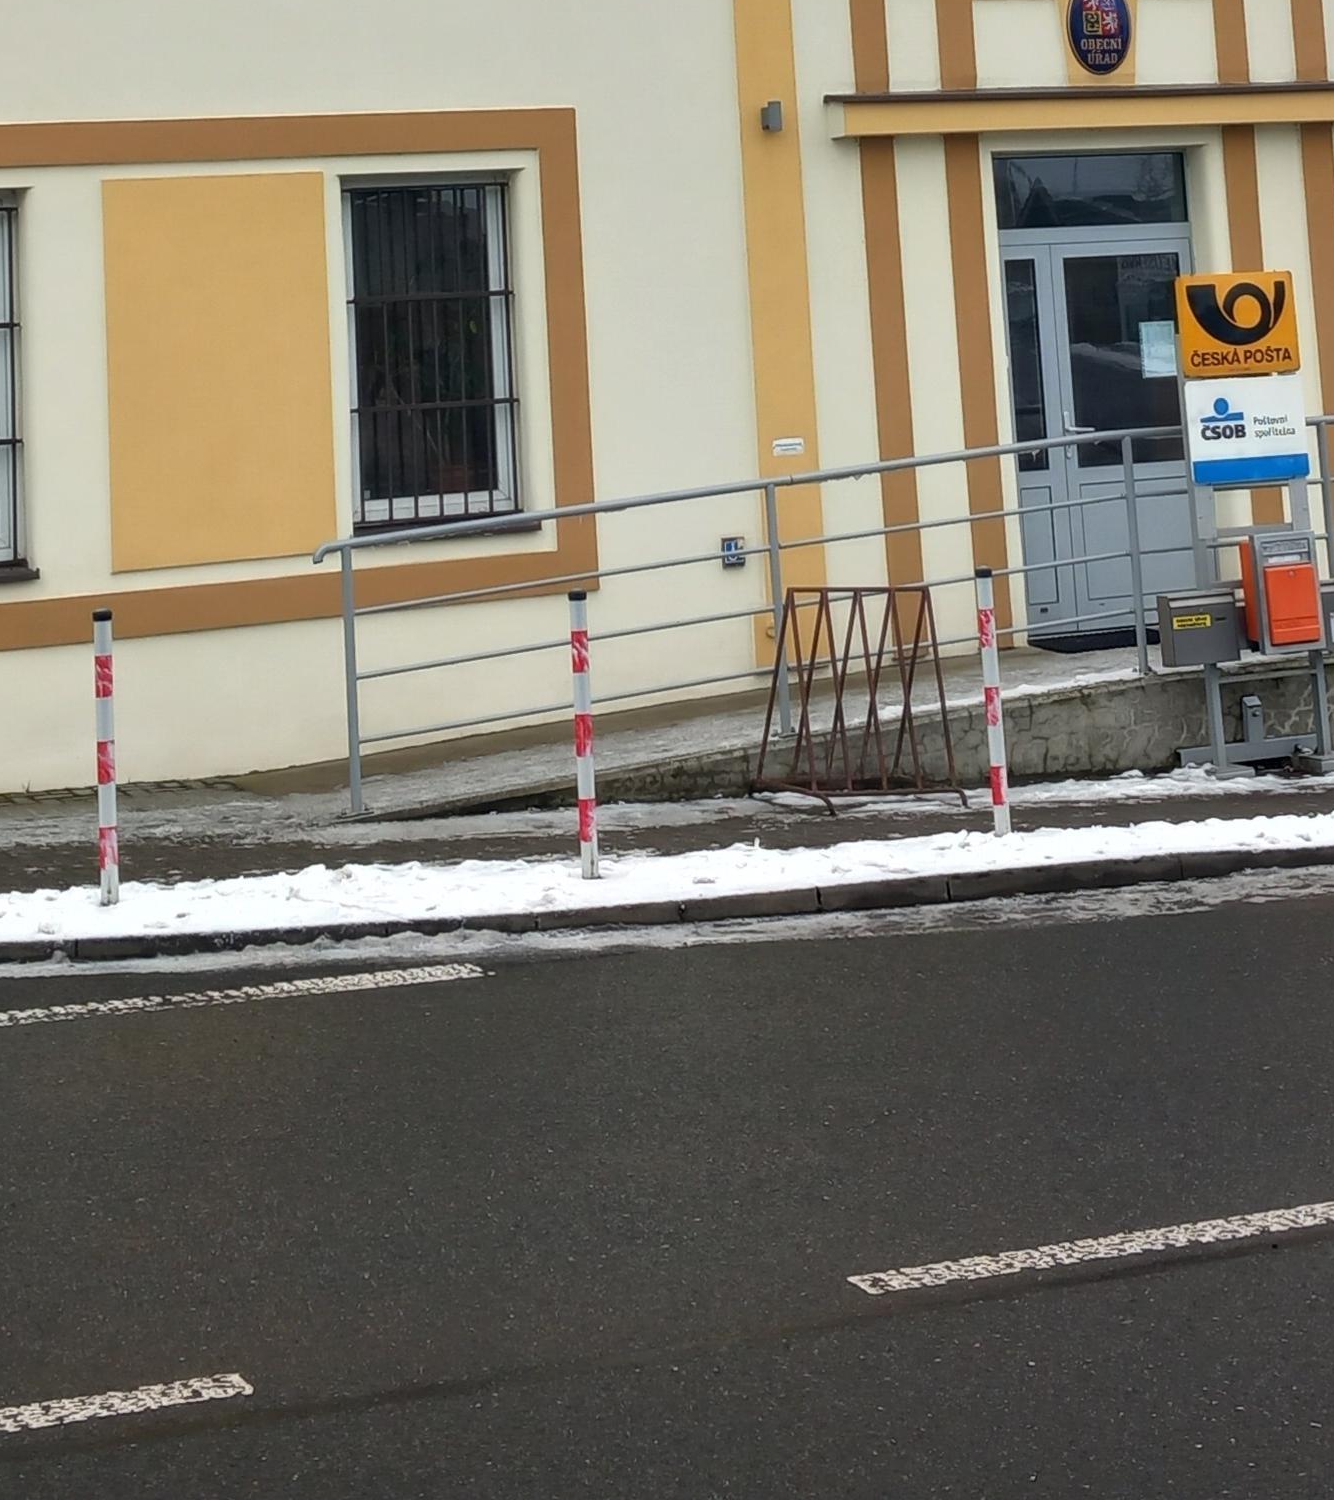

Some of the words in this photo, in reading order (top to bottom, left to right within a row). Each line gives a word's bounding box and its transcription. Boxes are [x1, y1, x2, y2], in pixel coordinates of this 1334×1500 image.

[1081, 37, 1122, 50] OBECNÍ
[1087, 50, 1118, 65] ÚŘAD
[1190, 348, 1242, 368] ČESKÁ
[1243, 346, 1293, 365] POŠTA
[1201, 424, 1246, 440] ČSOB
